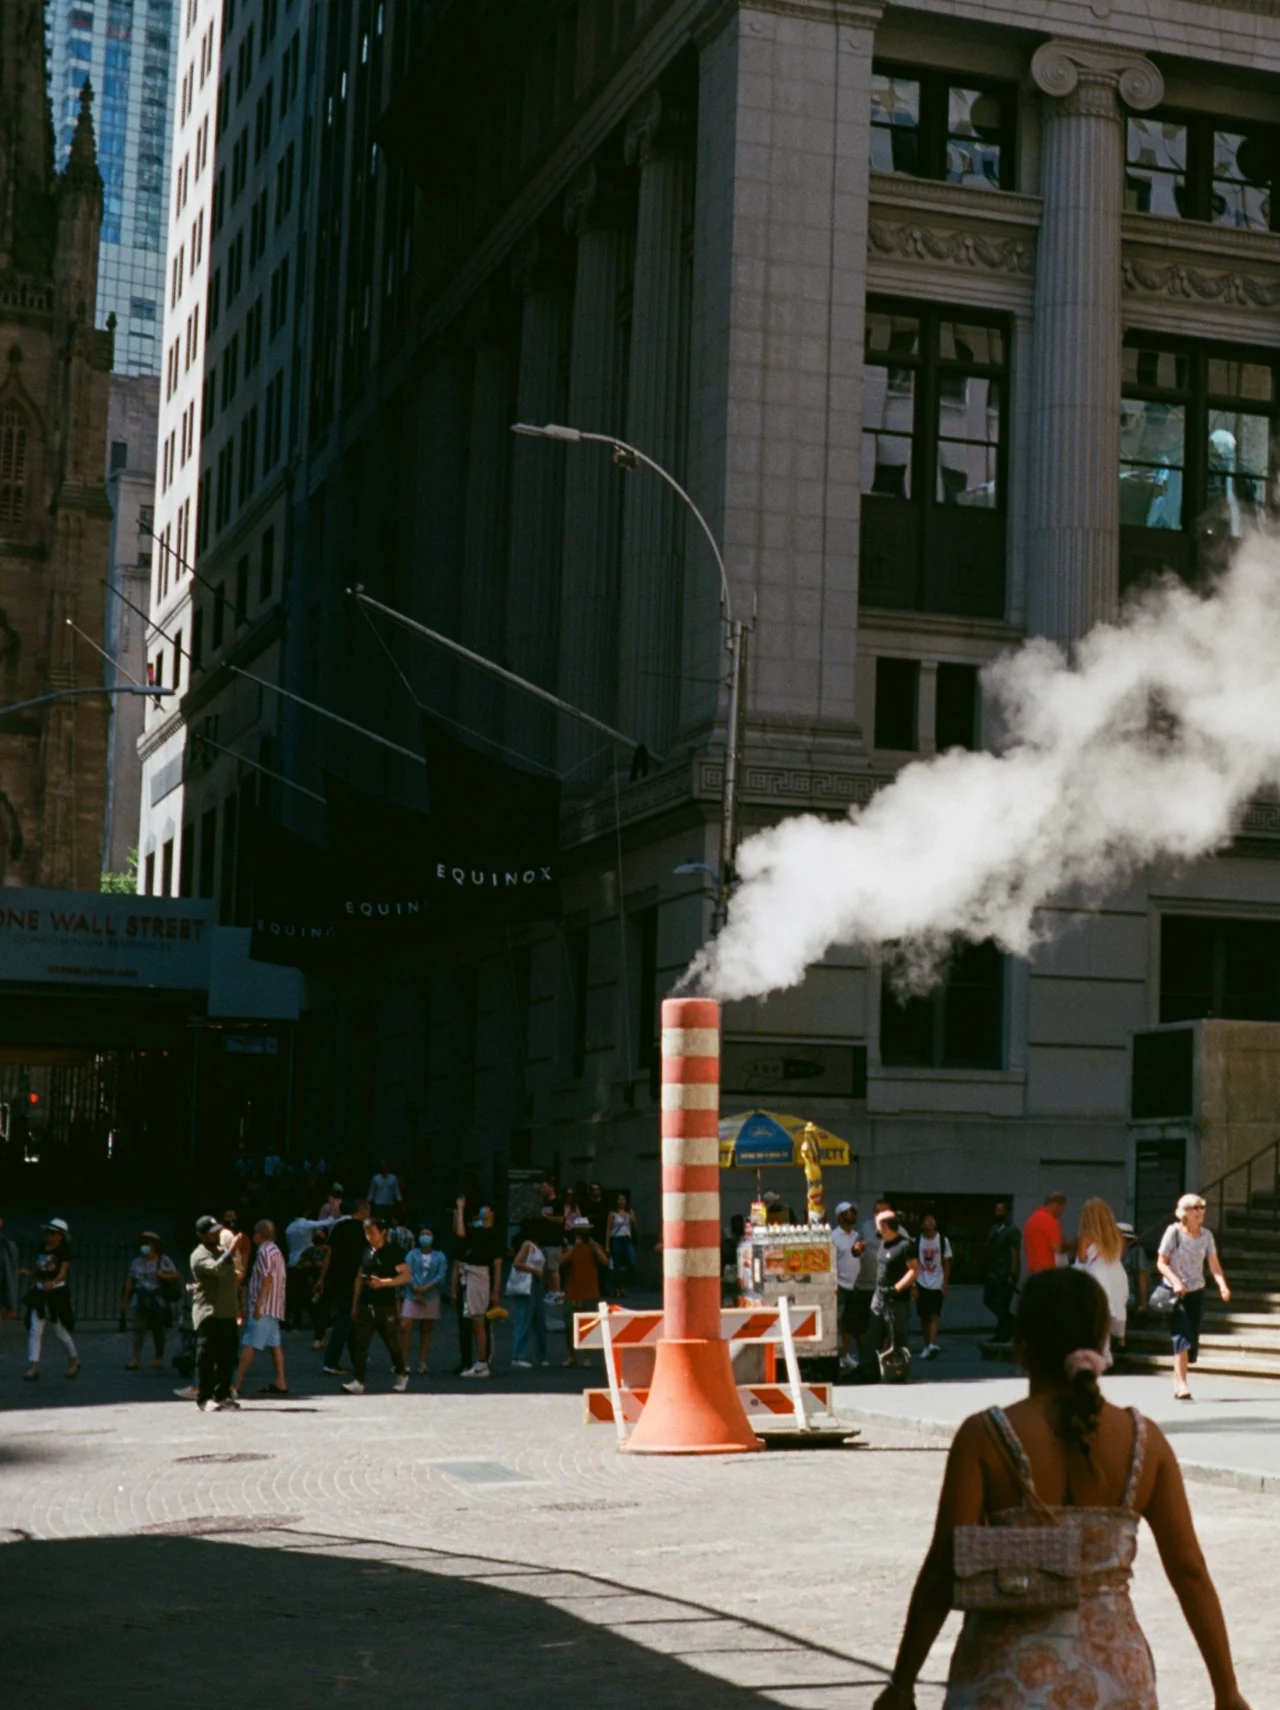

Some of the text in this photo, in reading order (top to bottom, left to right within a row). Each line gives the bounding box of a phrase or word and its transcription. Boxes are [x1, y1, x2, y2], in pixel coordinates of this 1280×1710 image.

[435, 862, 554, 888] EQUINOX
[343, 899, 429, 919] EQUIN
[49, 910, 116, 936] WALL
[125, 913, 206, 942] STREET
